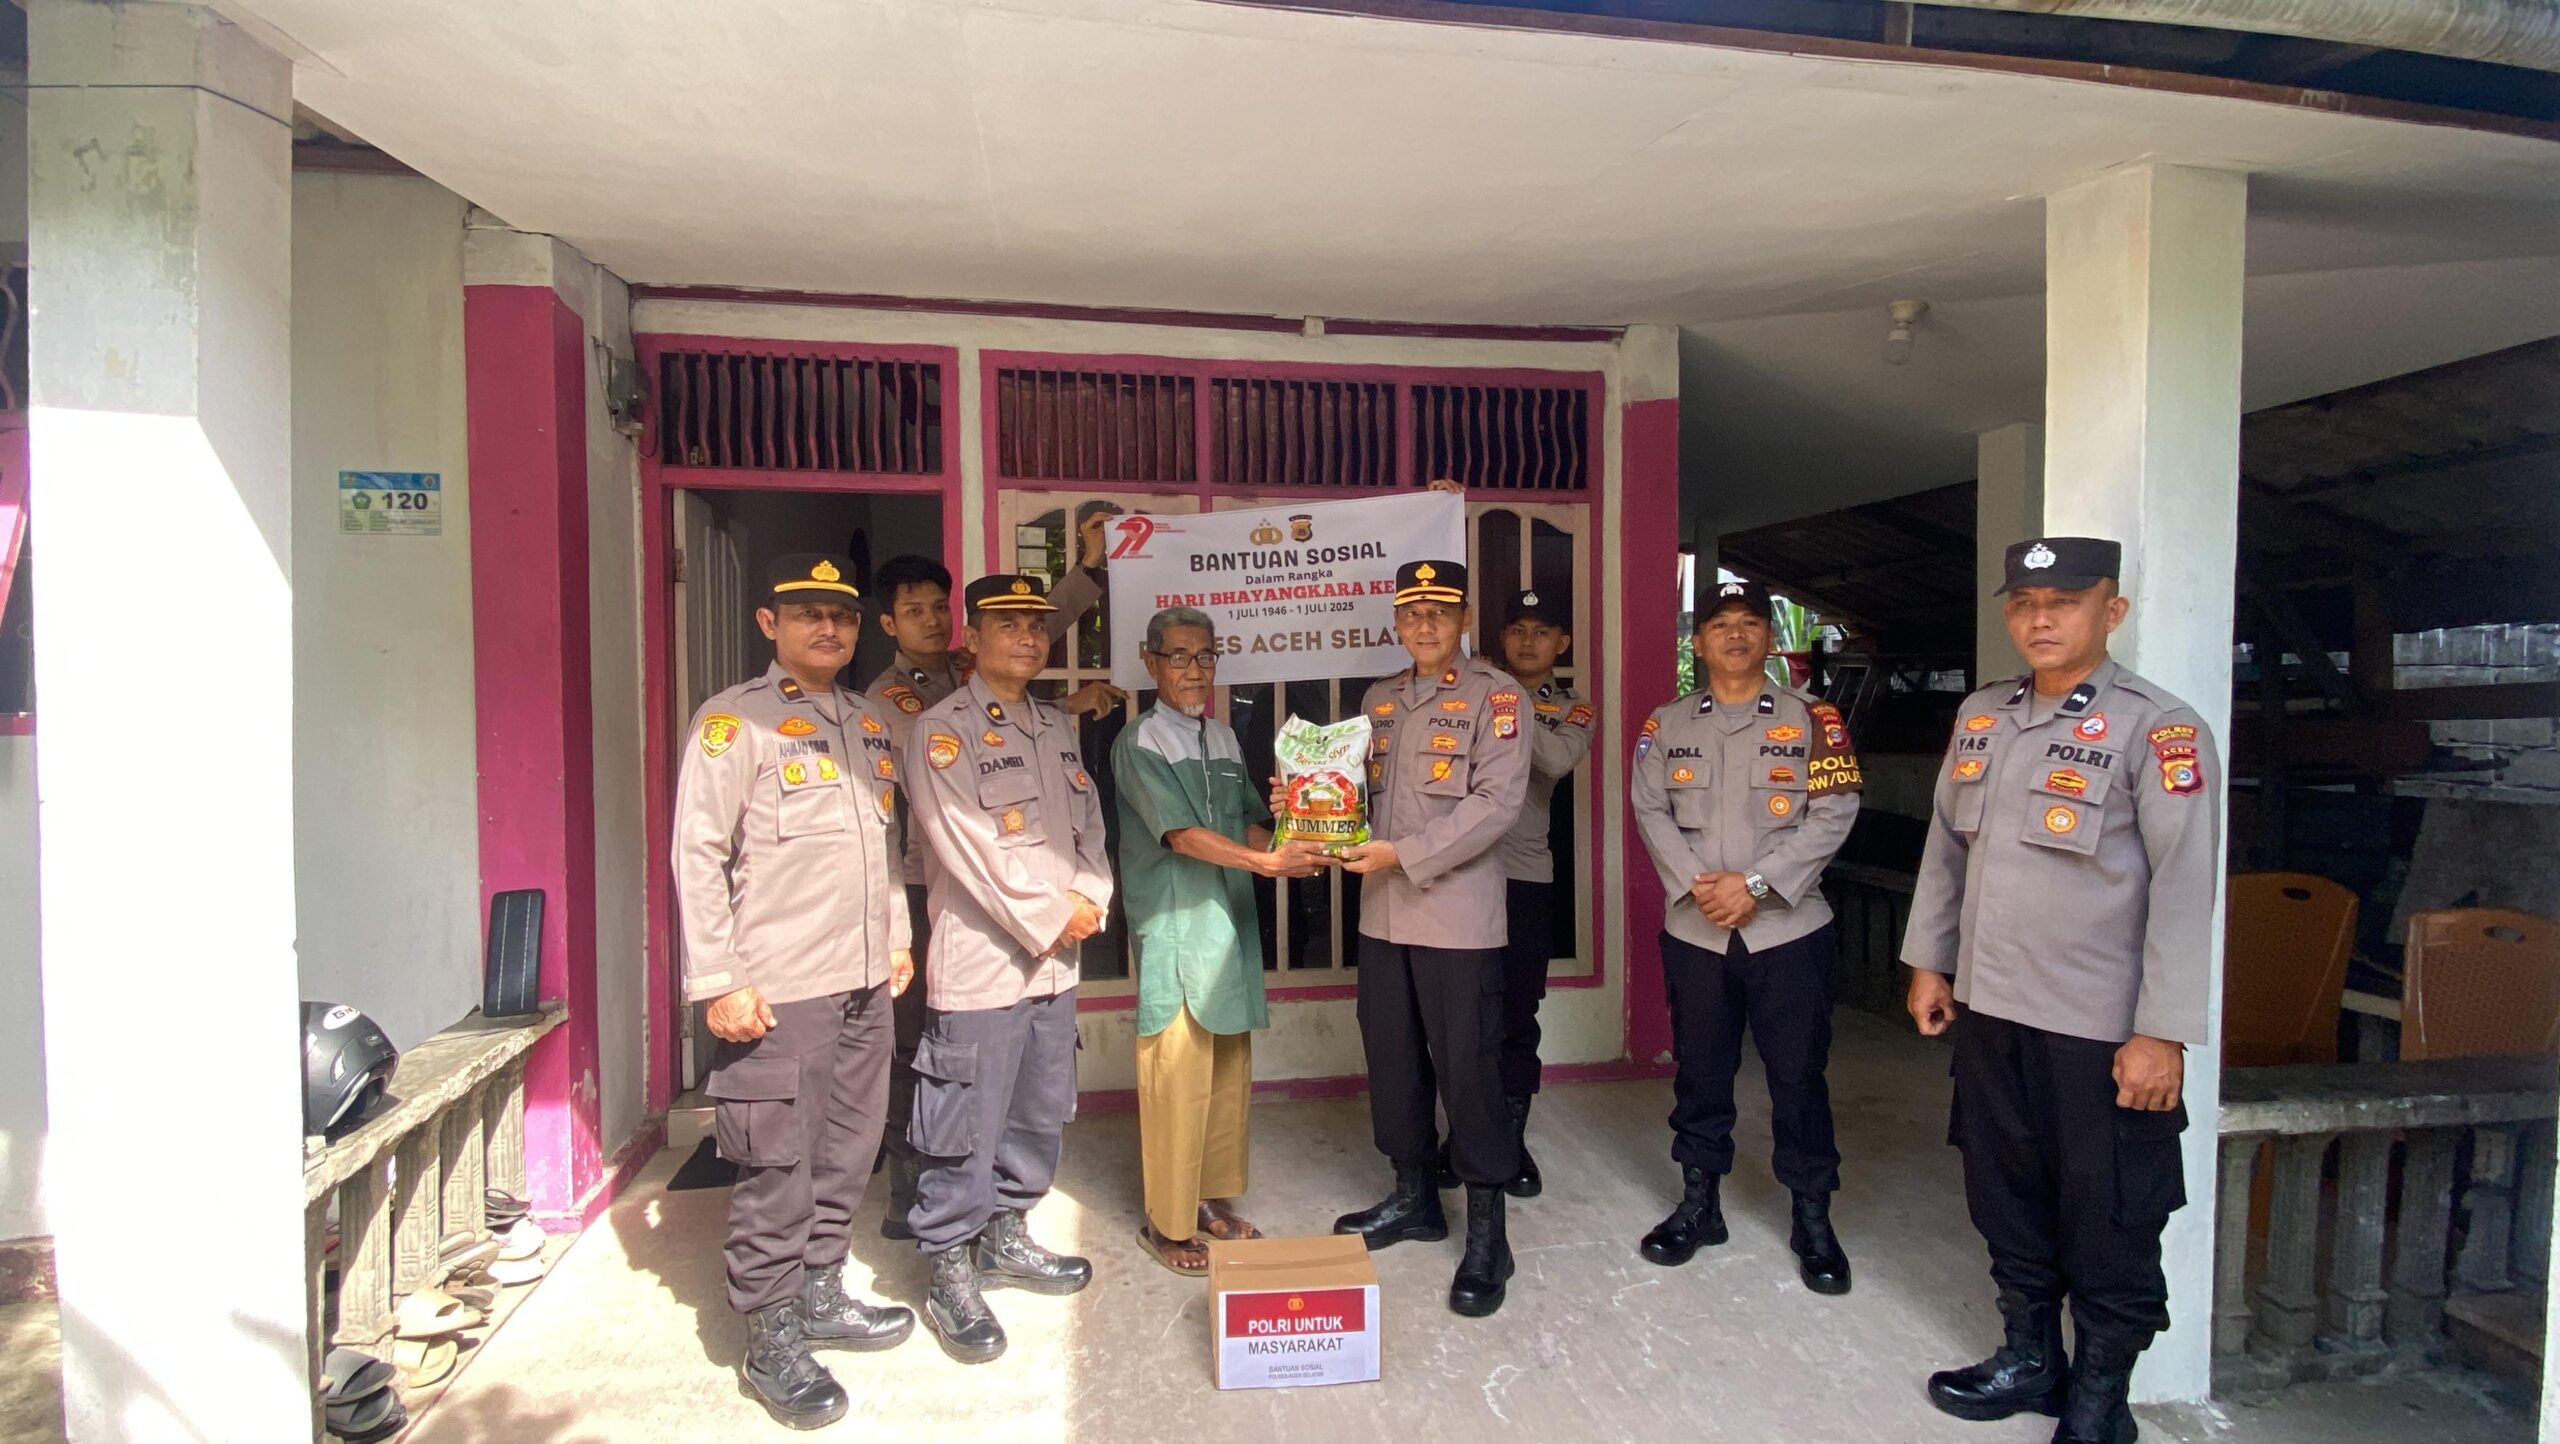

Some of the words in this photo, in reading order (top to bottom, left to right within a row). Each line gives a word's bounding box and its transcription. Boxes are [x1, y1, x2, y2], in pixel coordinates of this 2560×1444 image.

[382, 492, 428, 510] 120
[1190, 549, 1299, 572] BANTUAN
[1306, 541, 1387, 565] SOSIAL
[1245, 573, 1285, 585] Dalam
[1288, 569, 1333, 582] Rangka
[1155, 593, 1205, 608] HARI
[1210, 582, 1365, 606] BHAYANGKARA
[1228, 610, 1233, 619] 1
[1236, 608, 1259, 620] JULI
[1262, 606, 1287, 617] 1946
[1296, 605, 1302, 614] 1
[1304, 603, 1327, 615] JULI
[1329, 601, 1354, 612] 2025
[1250, 631, 1322, 654] ACEH
[1428, 717, 1470, 730] POLRI
[1760, 746, 1805, 758] POLRI
[2045, 743, 2113, 770] POLRI
[2163, 747, 2192, 756] ACEH
[1248, 1318, 1291, 1334] POLRI
[1294, 1316, 1343, 1332] UNTUK
[1248, 1337, 1344, 1355] MASYARAKAT
